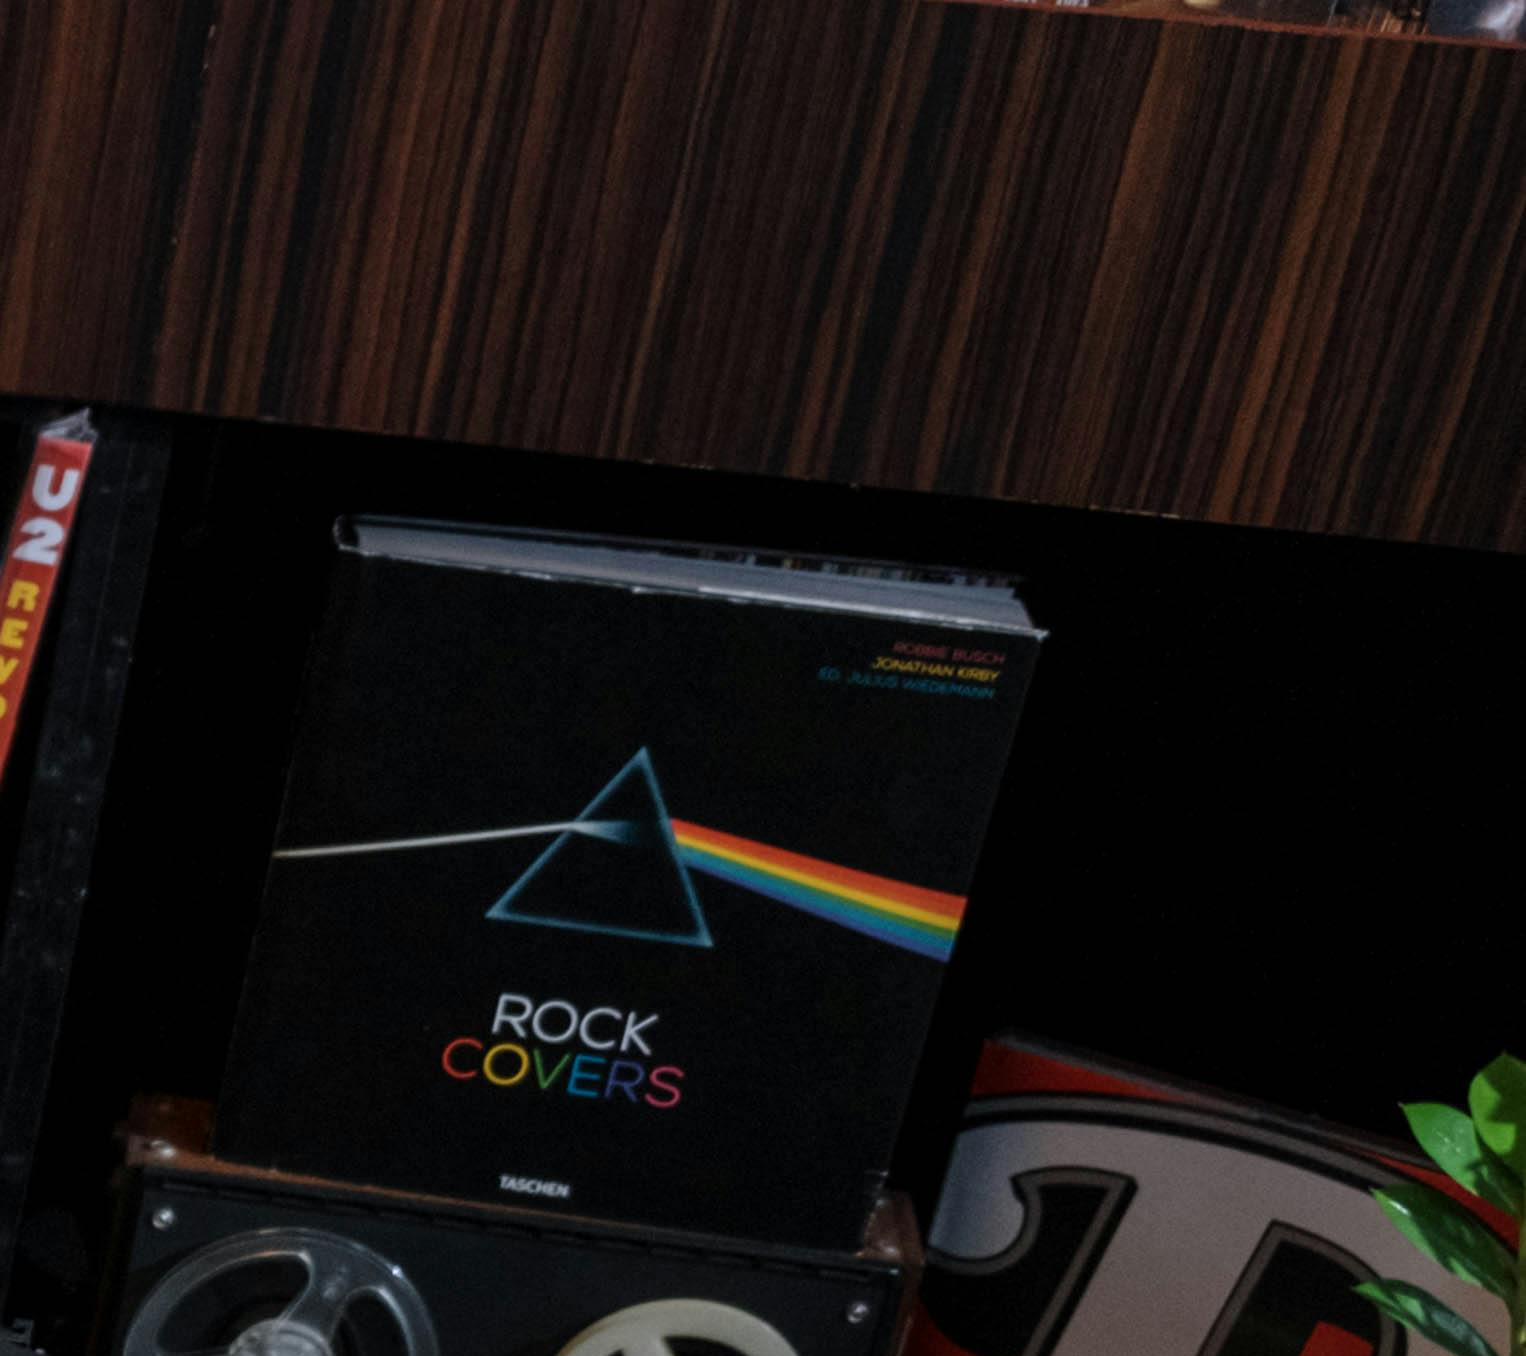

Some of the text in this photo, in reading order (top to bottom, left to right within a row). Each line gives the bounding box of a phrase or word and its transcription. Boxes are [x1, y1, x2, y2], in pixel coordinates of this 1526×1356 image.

[12, 464, 79, 567] U2
[893, 640, 1006, 666] ROBBIE BUSCH
[872, 656, 1001, 683] JONATHAN KIRBY
[847, 670, 897, 690] JULIUS
[901, 676, 995, 699] WIEDEMANN
[491, 993, 659, 1056] ROCK
[441, 1037, 685, 1109] COVERS
[499, 1175, 570, 1198] TASCHEN
